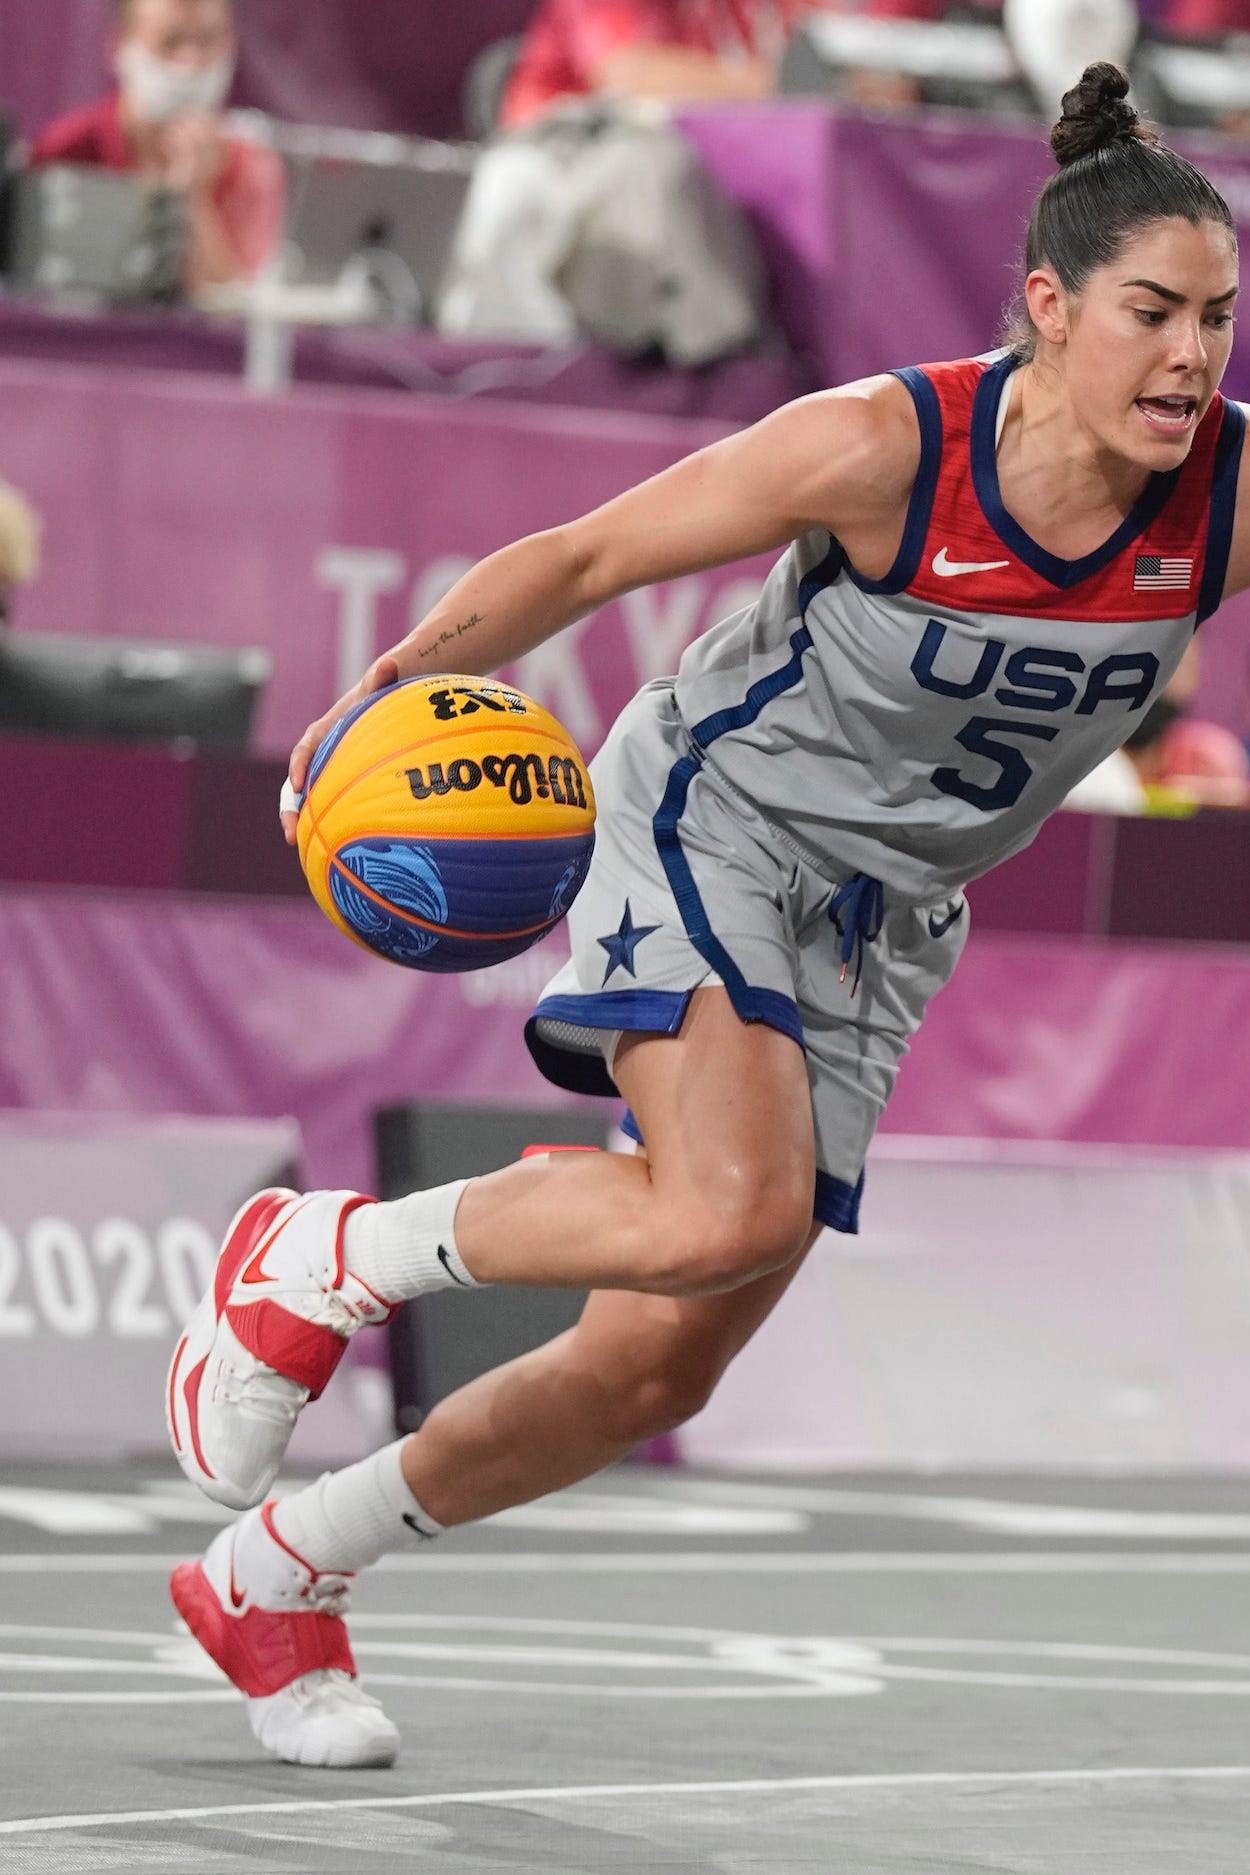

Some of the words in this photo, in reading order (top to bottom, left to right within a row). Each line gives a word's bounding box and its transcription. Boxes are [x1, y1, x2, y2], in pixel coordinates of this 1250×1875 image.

[439, 631, 456, 644] the
[457, 612, 488, 636] faith
[910, 618, 1160, 715] USA
[405, 753, 588, 810] Wilson
[929, 715, 1060, 812] 5
